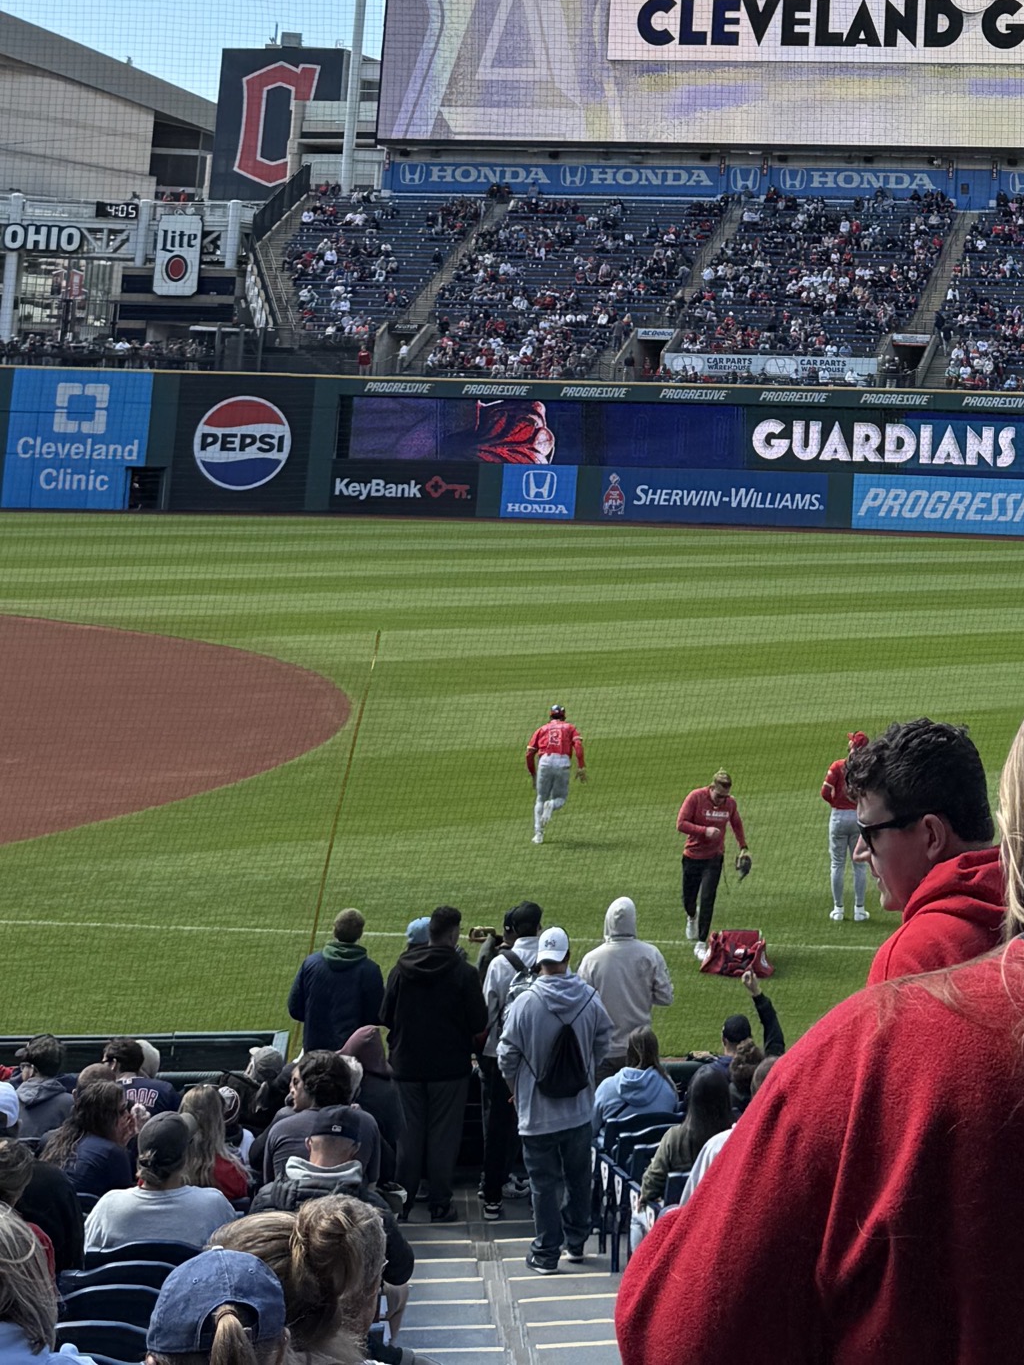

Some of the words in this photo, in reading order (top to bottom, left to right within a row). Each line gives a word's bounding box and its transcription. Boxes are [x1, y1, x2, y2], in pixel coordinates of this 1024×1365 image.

[428, 166, 551, 184] HONDA
[590, 168, 714, 186] HONDA
[810, 171, 937, 190] HONDA
[107, 204, 136, 218] 4:05
[4, 224, 81, 252] OHIO
[160, 229, 197, 253] Lite
[726, 357, 753, 365] PARTS
[800, 358, 818, 366] CAR
[819, 359, 847, 367] PARTS
[364, 381, 431, 394] PROGRESSIVE
[462, 384, 529, 396] PROGRESSIVE
[560, 386, 628, 398] PROGRESSIVE
[660, 388, 728, 400] PROGRESSIVE
[759, 391, 827, 403] PROGRESSIVE
[860, 393, 929, 405] PROGRESSIVE
[17, 436, 139, 461] Cleveland
[201, 432, 285, 453] PEPSI
[752, 418, 1016, 468] GUARDIANS
[39, 468, 109, 491] Clinic
[334, 477, 422, 501] KeyBank
[633, 485, 821, 510] SHERWIN-WILLIAMS
[506, 503, 568, 515] HONDA
